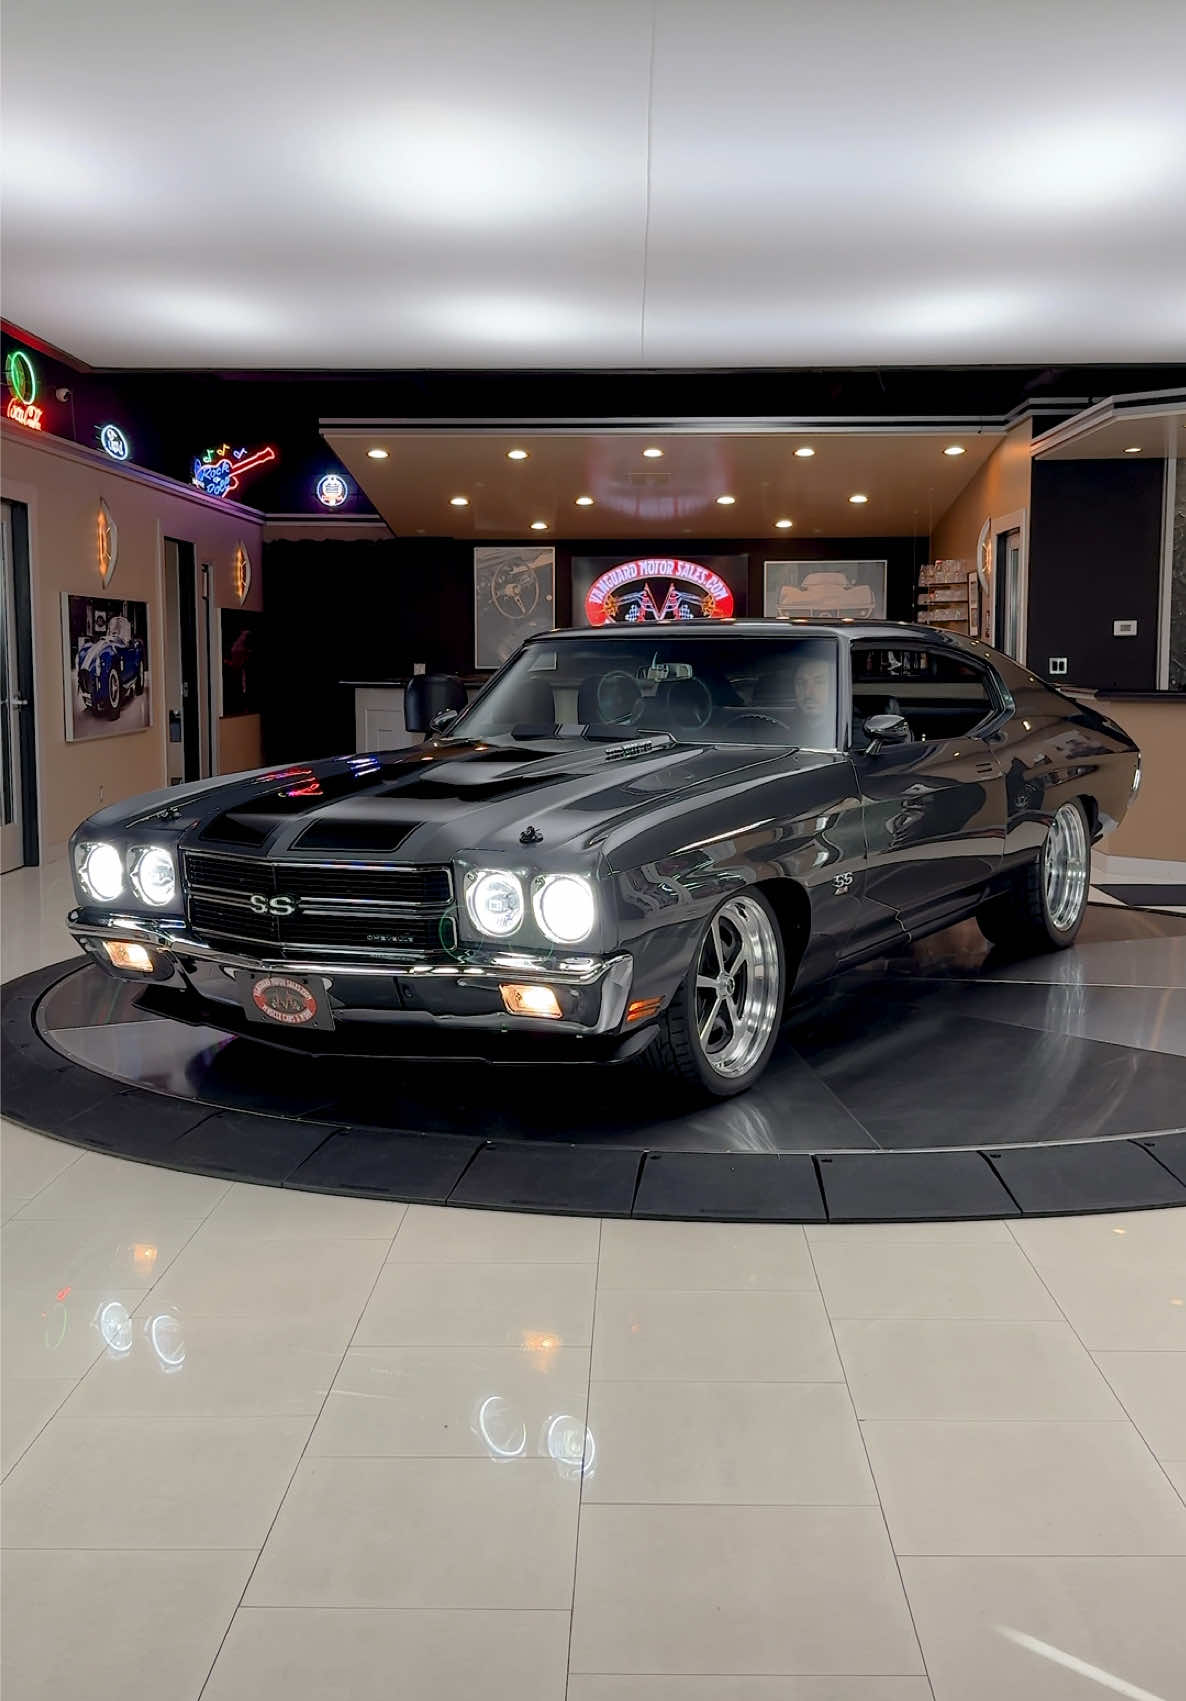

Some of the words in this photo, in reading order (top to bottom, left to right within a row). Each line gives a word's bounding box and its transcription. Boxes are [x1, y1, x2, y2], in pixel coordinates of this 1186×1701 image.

[588, 564, 638, 604] VANGUARD
[638, 560, 674, 576] MOTOR
[675, 561, 729, 599] SALES.COM
[832, 872, 853, 888] SS
[250, 895, 294, 915] SS
